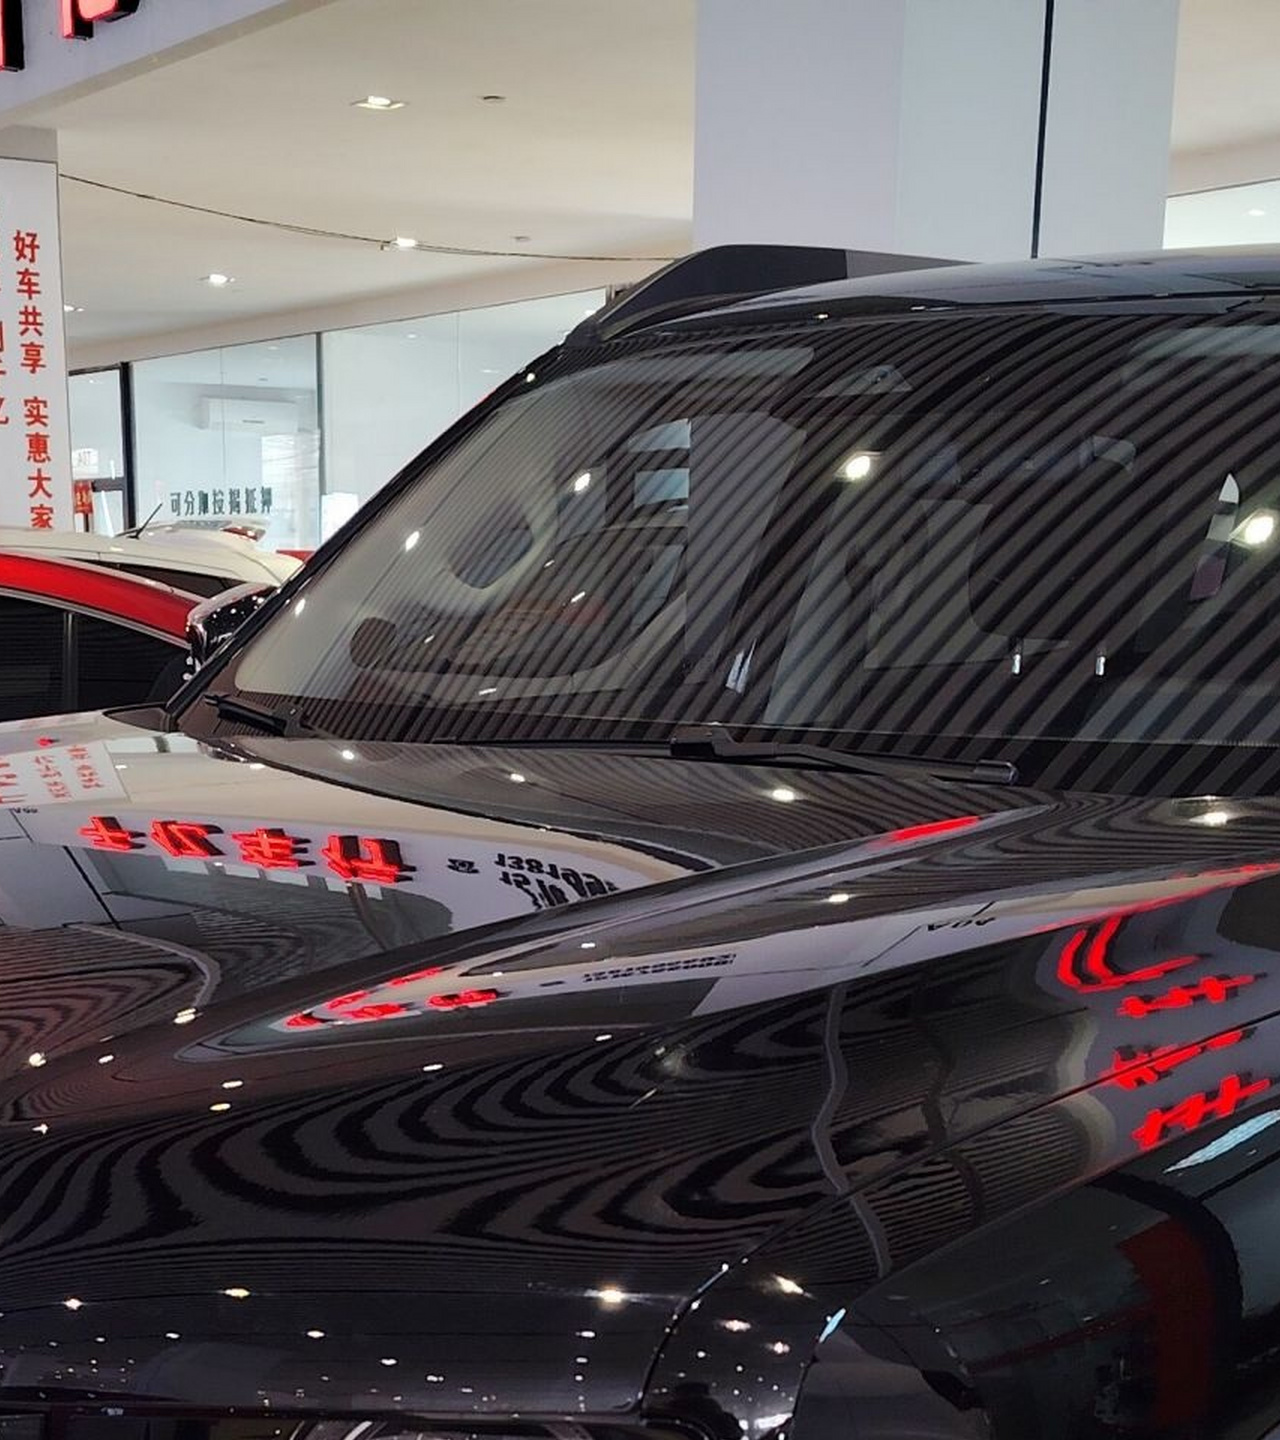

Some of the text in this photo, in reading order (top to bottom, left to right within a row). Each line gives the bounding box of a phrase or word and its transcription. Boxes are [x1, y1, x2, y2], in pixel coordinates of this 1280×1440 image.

[14, 229, 54, 529] 好车共享 实惠大家
